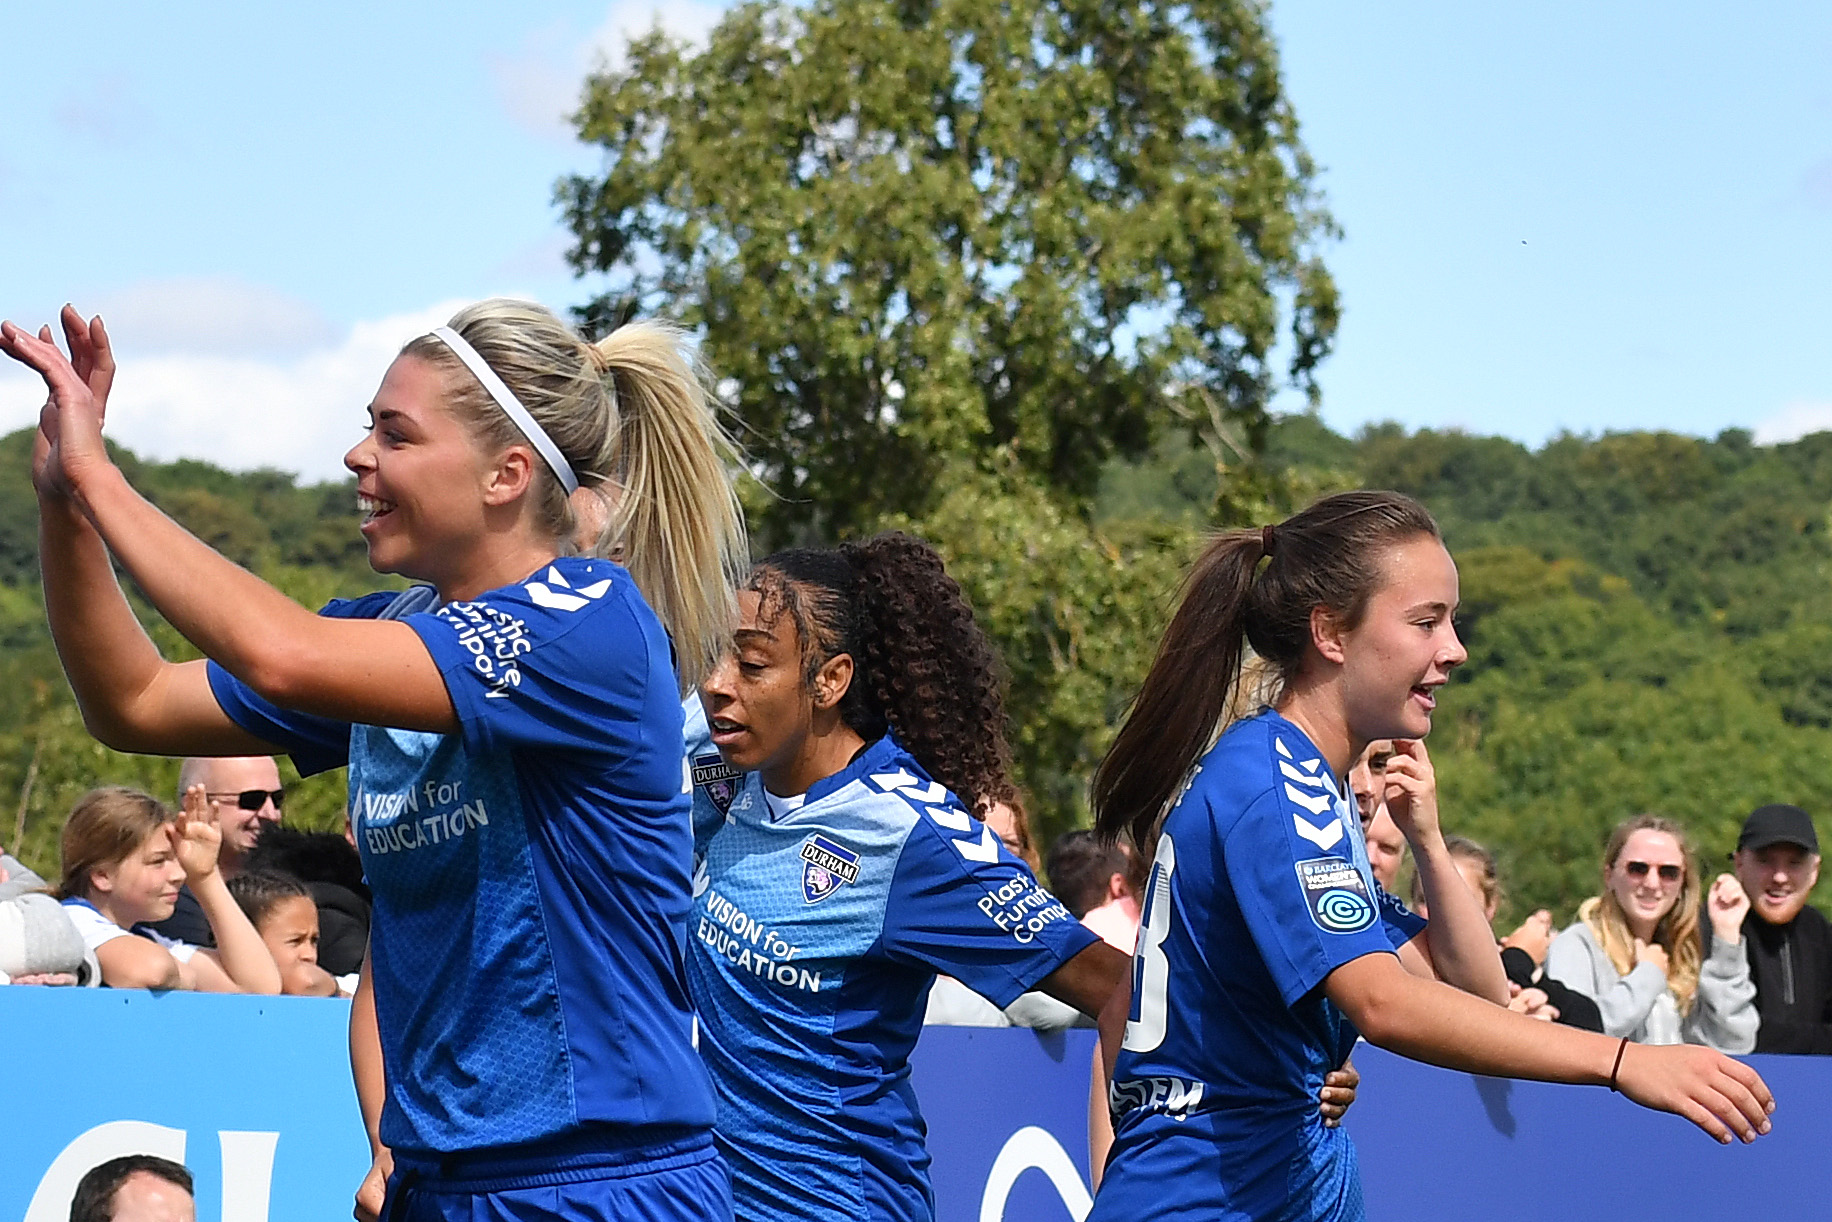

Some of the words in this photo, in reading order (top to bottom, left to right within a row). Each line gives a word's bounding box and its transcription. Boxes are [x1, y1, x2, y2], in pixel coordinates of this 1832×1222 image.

[424, 781, 462, 808] for
[696, 766, 740, 782] DURH
[365, 799, 488, 855] EDUCATION
[804, 844, 855, 879] DURHAM
[707, 891, 764, 945] VISION
[763, 931, 800, 961] for
[697, 916, 821, 993] EDUCATION
